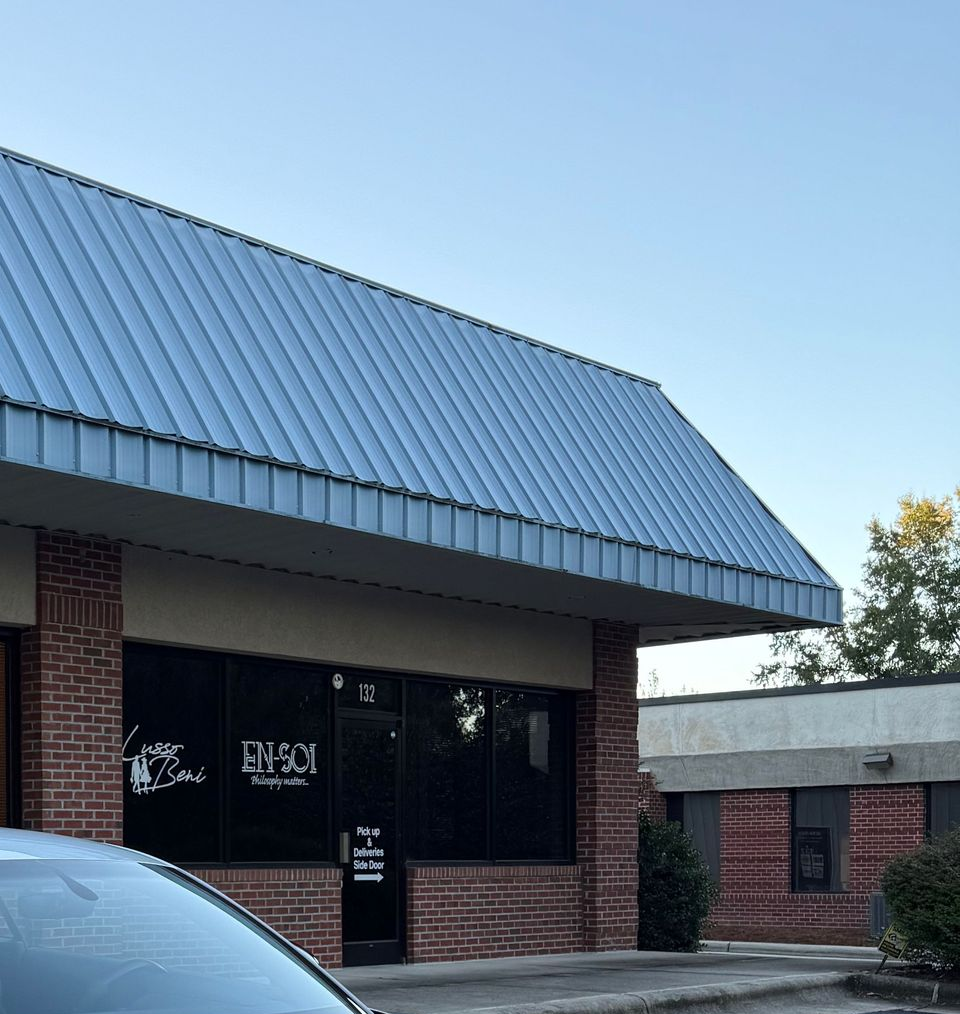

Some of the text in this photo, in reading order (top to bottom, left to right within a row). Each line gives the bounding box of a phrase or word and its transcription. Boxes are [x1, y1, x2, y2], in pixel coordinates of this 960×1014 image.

[359, 683, 375, 702] 132
[122, 724, 184, 762] Lusso
[241, 741, 317, 773] EN-SOI
[133, 755, 207, 793] Beni
[251, 774, 283, 790] Philosophy
[357, 827, 380, 838] Pick up
[367, 837, 372, 847] &
[354, 847, 384, 857] Deliveries
[354, 860, 384, 869] Side Door
